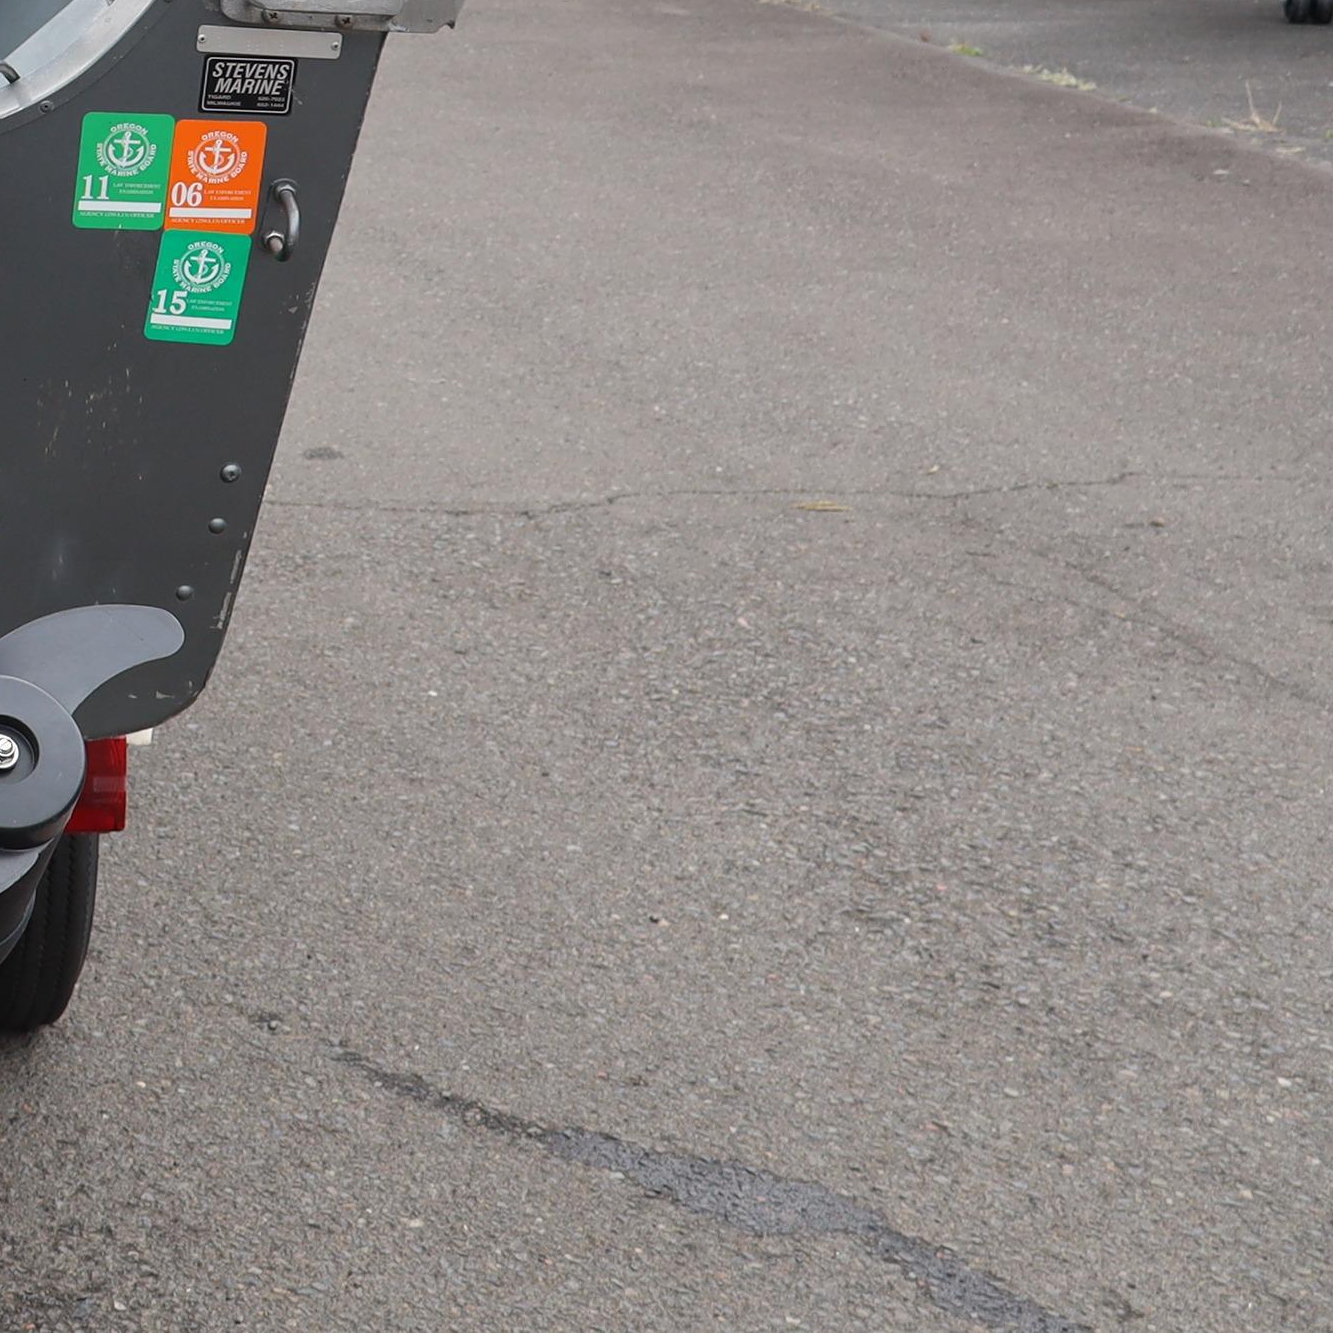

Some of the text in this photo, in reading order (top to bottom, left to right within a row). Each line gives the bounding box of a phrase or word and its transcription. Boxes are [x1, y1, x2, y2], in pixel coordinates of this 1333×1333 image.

[212, 61, 290, 79] STEVENS
[214, 78, 285, 95] MARINE
[110, 122, 149, 135] OREGON
[201, 131, 239, 143] OREGON
[96, 143, 157, 177] STATE MARINE BOARD
[187, 150, 248, 184] STATE MARINE BOARD
[81, 174, 109, 200] 11
[171, 181, 203, 207] 06
[187, 240, 224, 254] OREGON
[173, 259, 231, 293] STATE MARINE BOARD
[152, 289, 188, 315] 15
